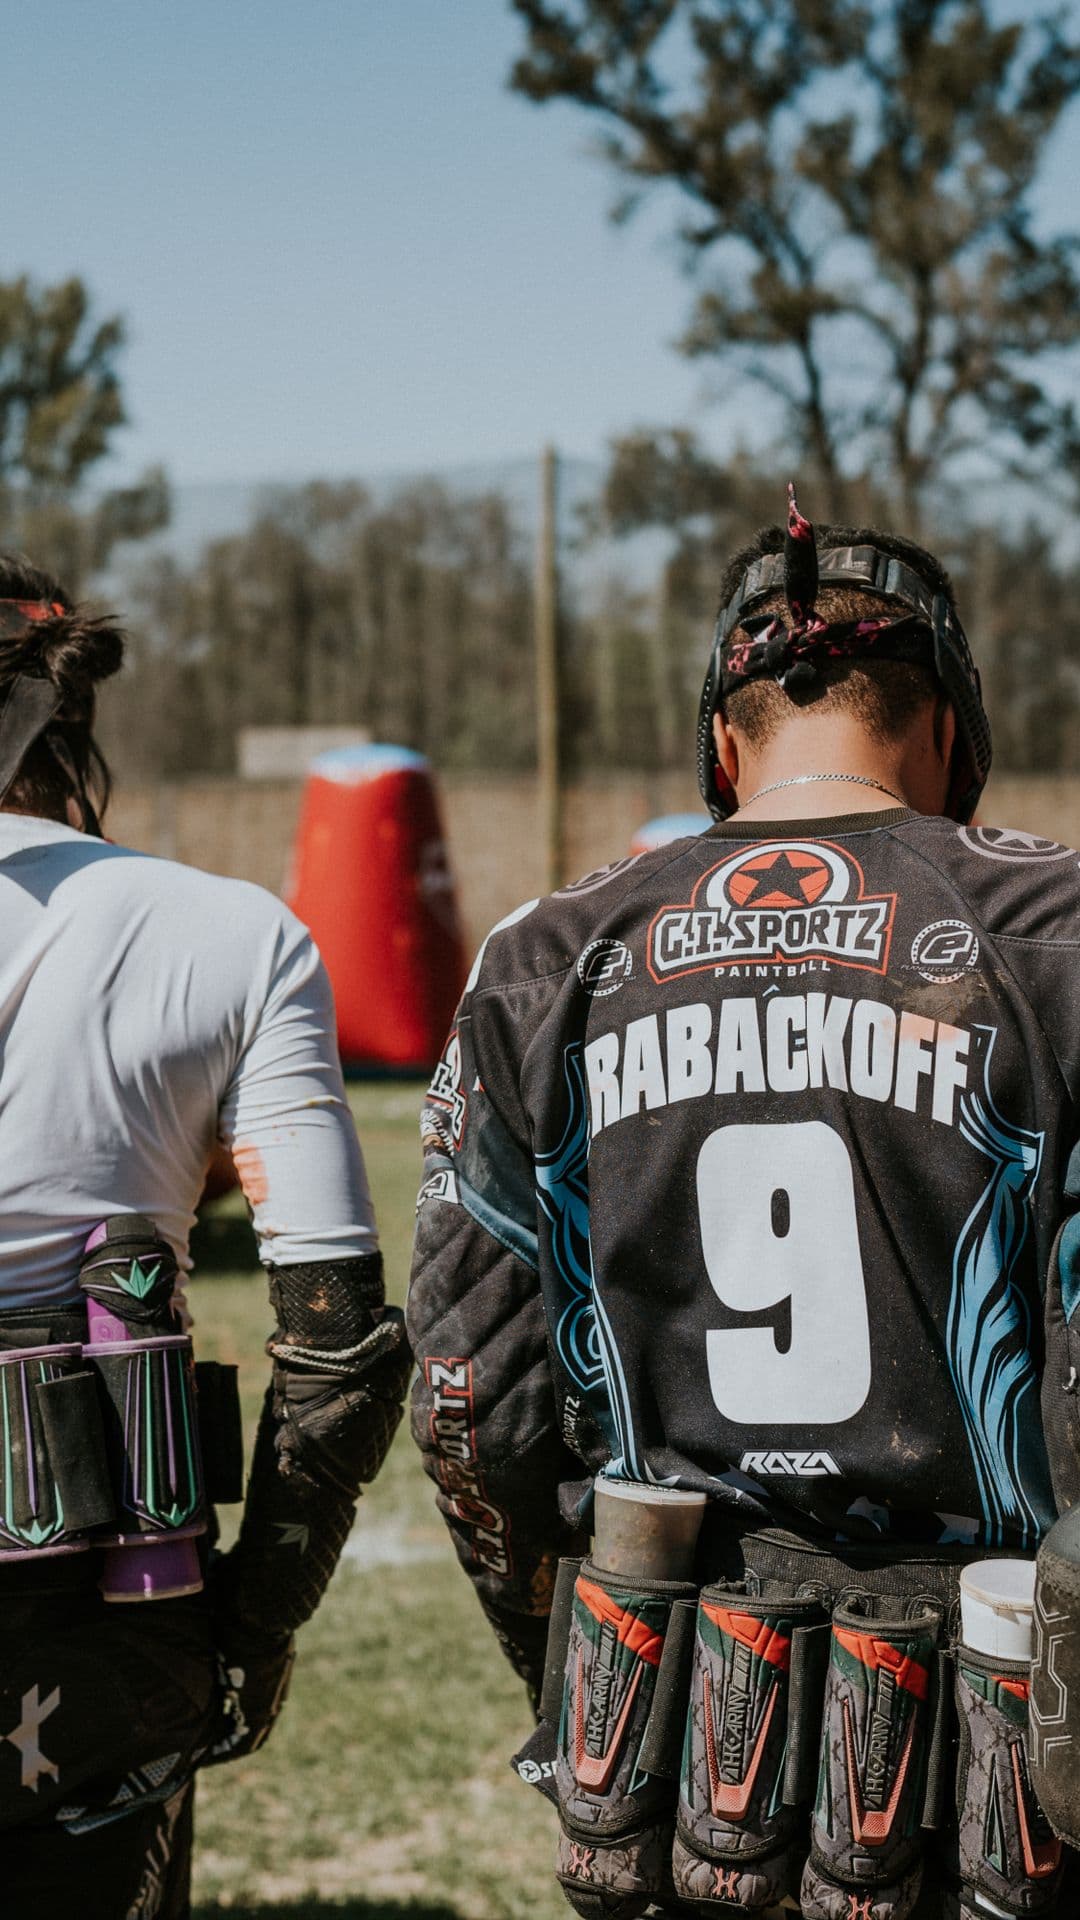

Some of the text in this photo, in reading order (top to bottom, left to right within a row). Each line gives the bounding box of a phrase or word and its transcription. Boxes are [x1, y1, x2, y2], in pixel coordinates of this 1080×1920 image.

[714, 959, 831, 978] PAINTBALL
[585, 992, 970, 1138] RABACKOFF
[696, 1120, 872, 1425] 9
[740, 1451, 842, 1476] RAZA
